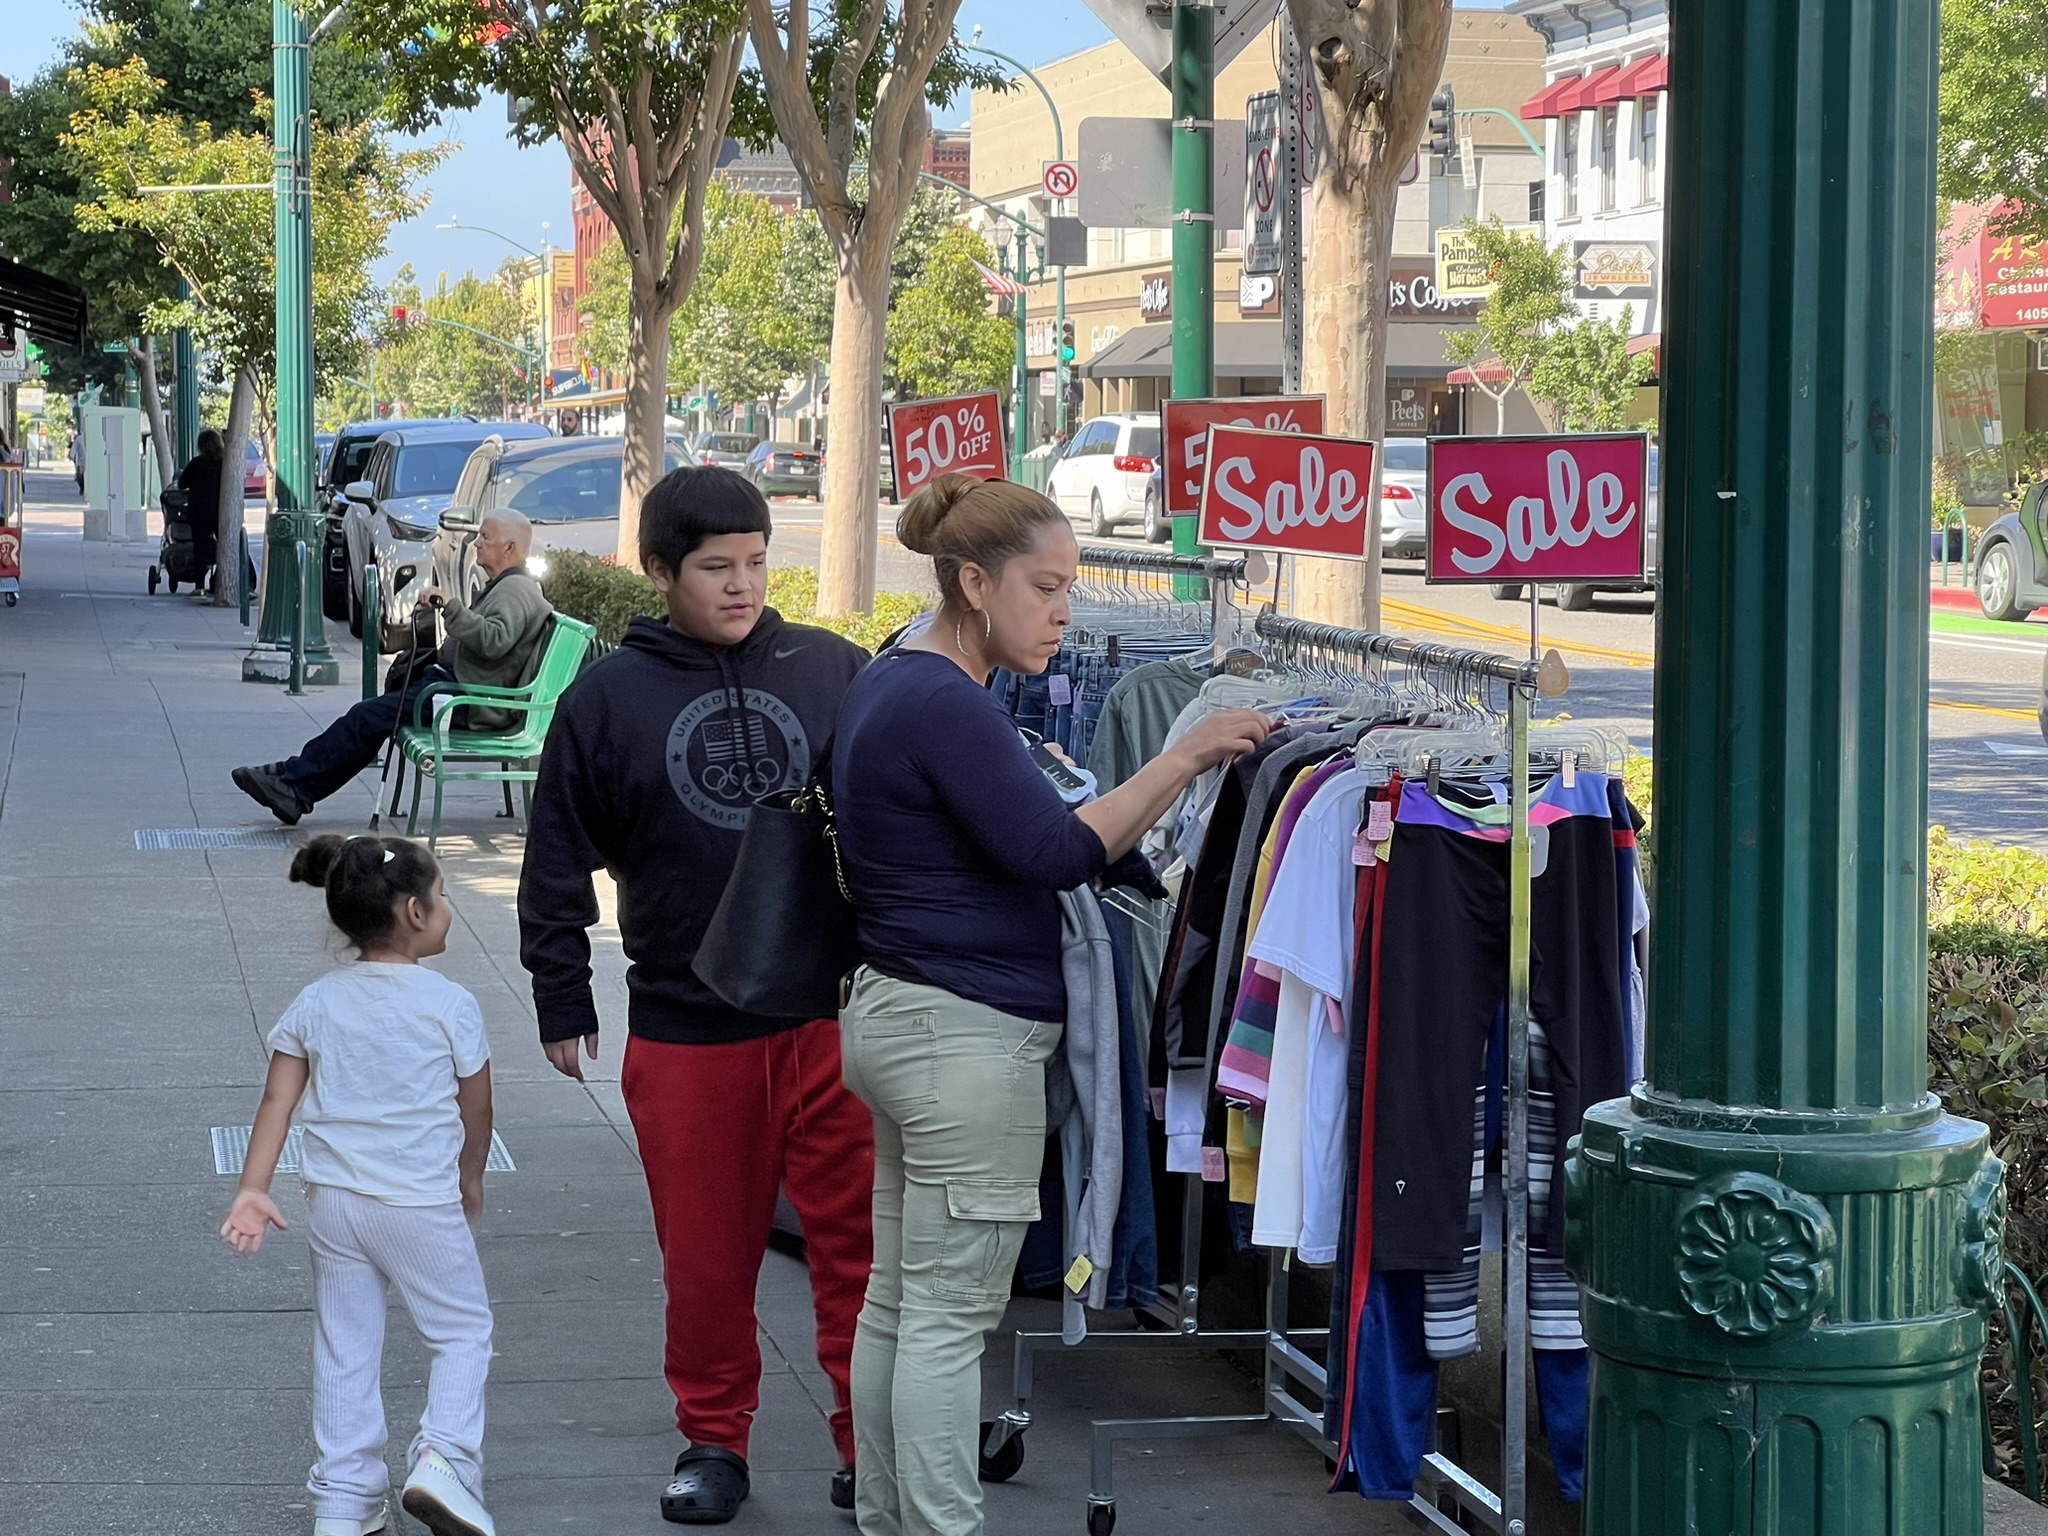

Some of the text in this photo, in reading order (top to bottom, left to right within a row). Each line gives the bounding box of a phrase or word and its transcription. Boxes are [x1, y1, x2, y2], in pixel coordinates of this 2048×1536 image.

[1255, 219, 1273, 234] ZONE
[1451, 236, 1466, 248] The
[1594, 250, 1644, 275] Park
[1390, 399, 1425, 421] Peet's
[958, 431, 991, 460] OFF
[1214, 446, 1365, 541] Sale
[1440, 448, 1637, 574] Sale
[674, 694, 723, 738] UNITED
[731, 692, 790, 724] STATES
[681, 783, 746, 823] OLYMPI
